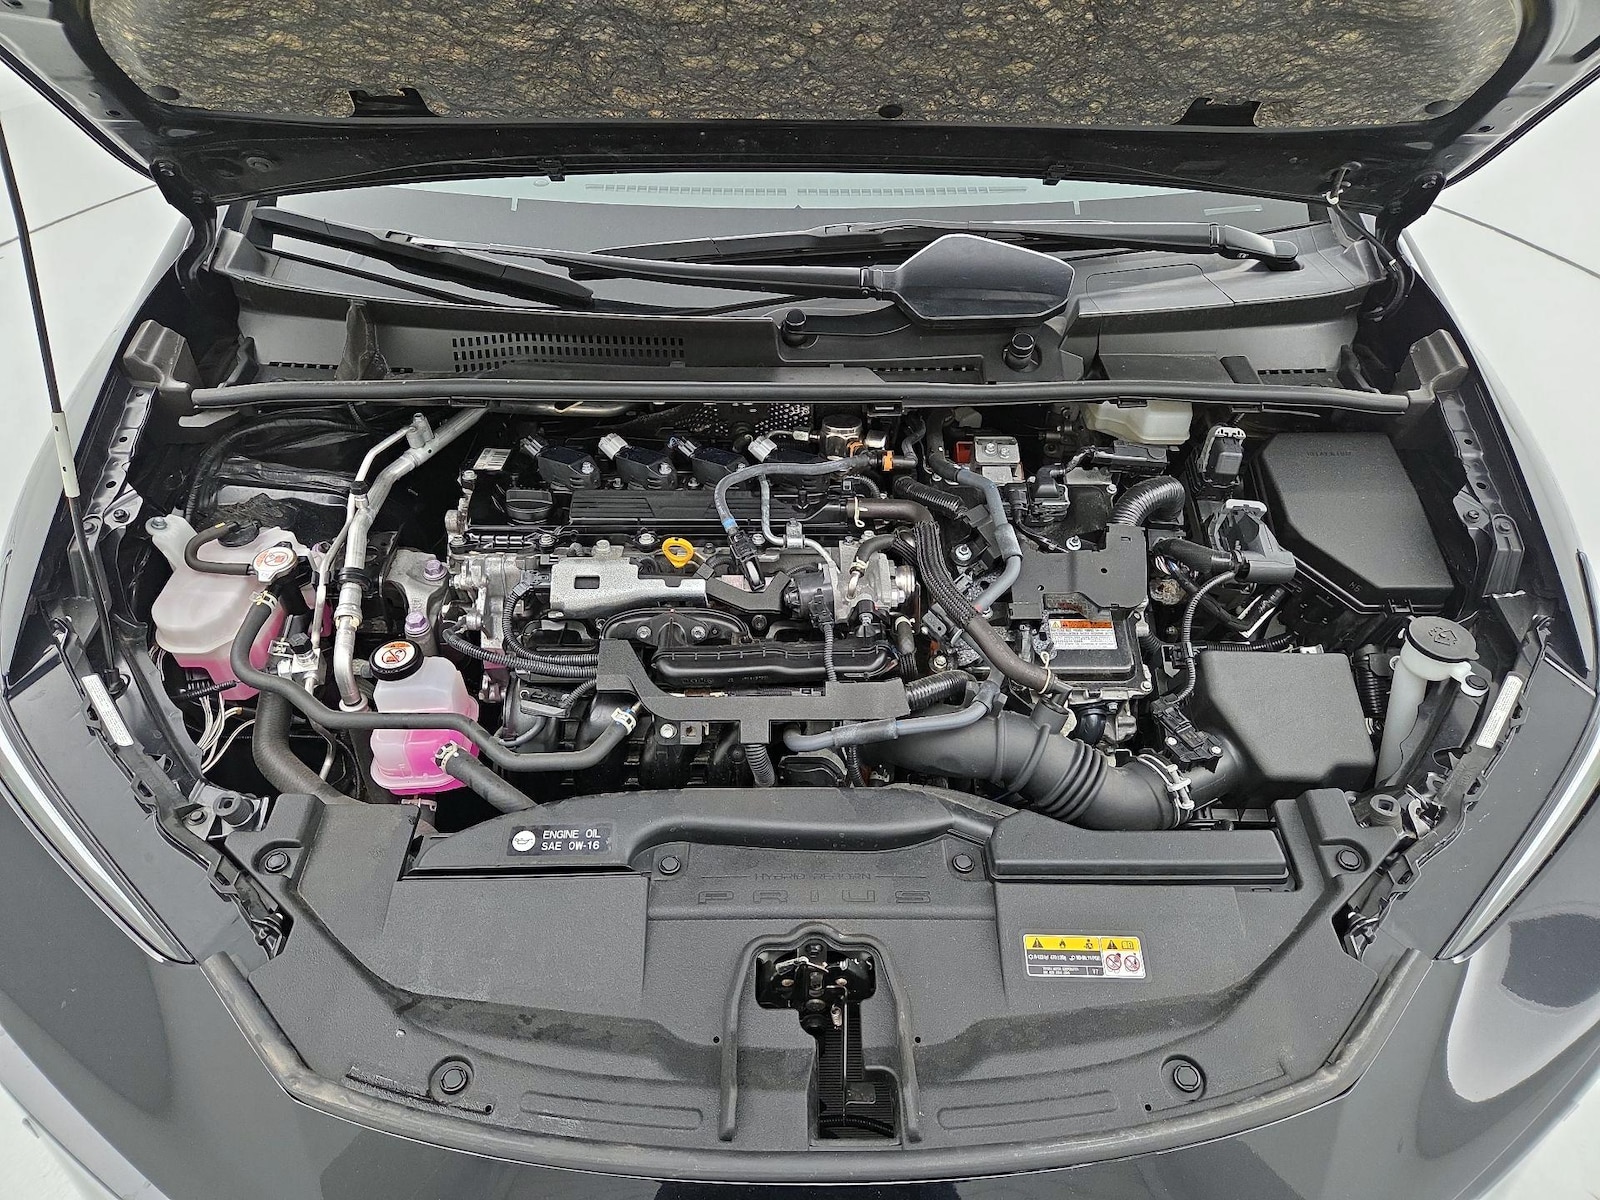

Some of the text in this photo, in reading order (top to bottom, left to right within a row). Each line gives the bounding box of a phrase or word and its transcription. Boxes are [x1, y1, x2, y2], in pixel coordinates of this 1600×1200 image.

[542, 828, 601, 840] ENGINE OIL
[541, 840, 600, 851] SAE 0W-16
[698, 889, 931, 904] PRIUS
